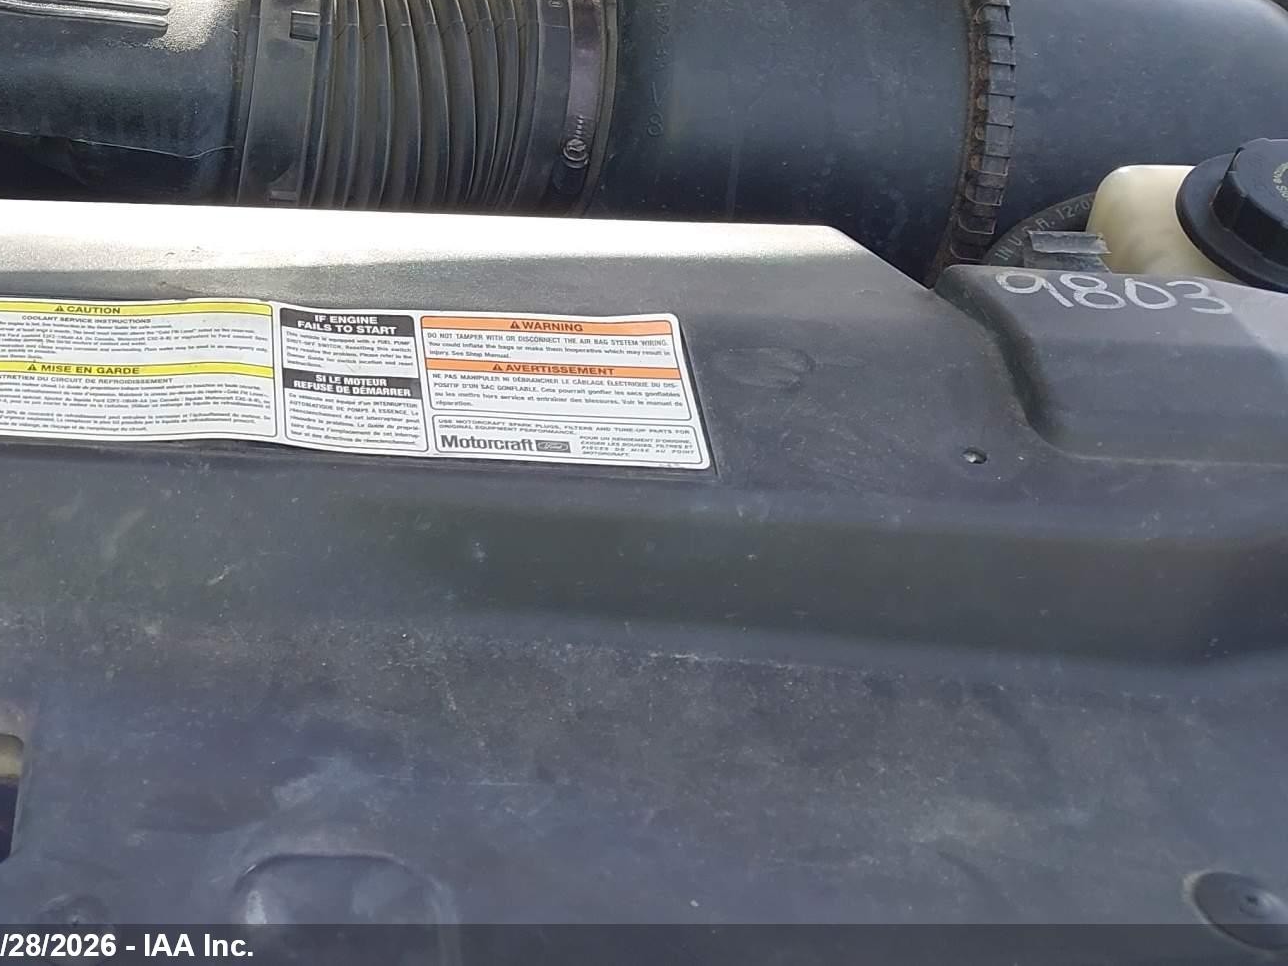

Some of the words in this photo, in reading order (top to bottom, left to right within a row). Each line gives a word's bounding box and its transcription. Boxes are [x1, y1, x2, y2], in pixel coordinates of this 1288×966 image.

[996, 271, 1233, 315] 9803
[67, 306, 121, 314] CAUTION
[314, 315, 326, 323] IF
[329, 315, 378, 325] ENGINE
[297, 321, 332, 331] FAILS
[335, 325, 352, 333] TO
[356, 325, 397, 335] START
[522, 321, 583, 332] WARNING
[41, 364, 72, 372] MISE
[75, 365, 92, 374] EN
[96, 367, 141, 375] GARDE
[506, 364, 615, 375] AVERTISSEMENT
[315, 374, 326, 382] SI
[329, 376, 342, 384] LE
[344, 377, 387, 387] MOTEUR
[293, 380, 334, 392] REFUSE
[336, 385, 351, 394] DE
[352, 386, 411, 397] DÉMARRER
[440, 435, 535, 451] Motorcraft
